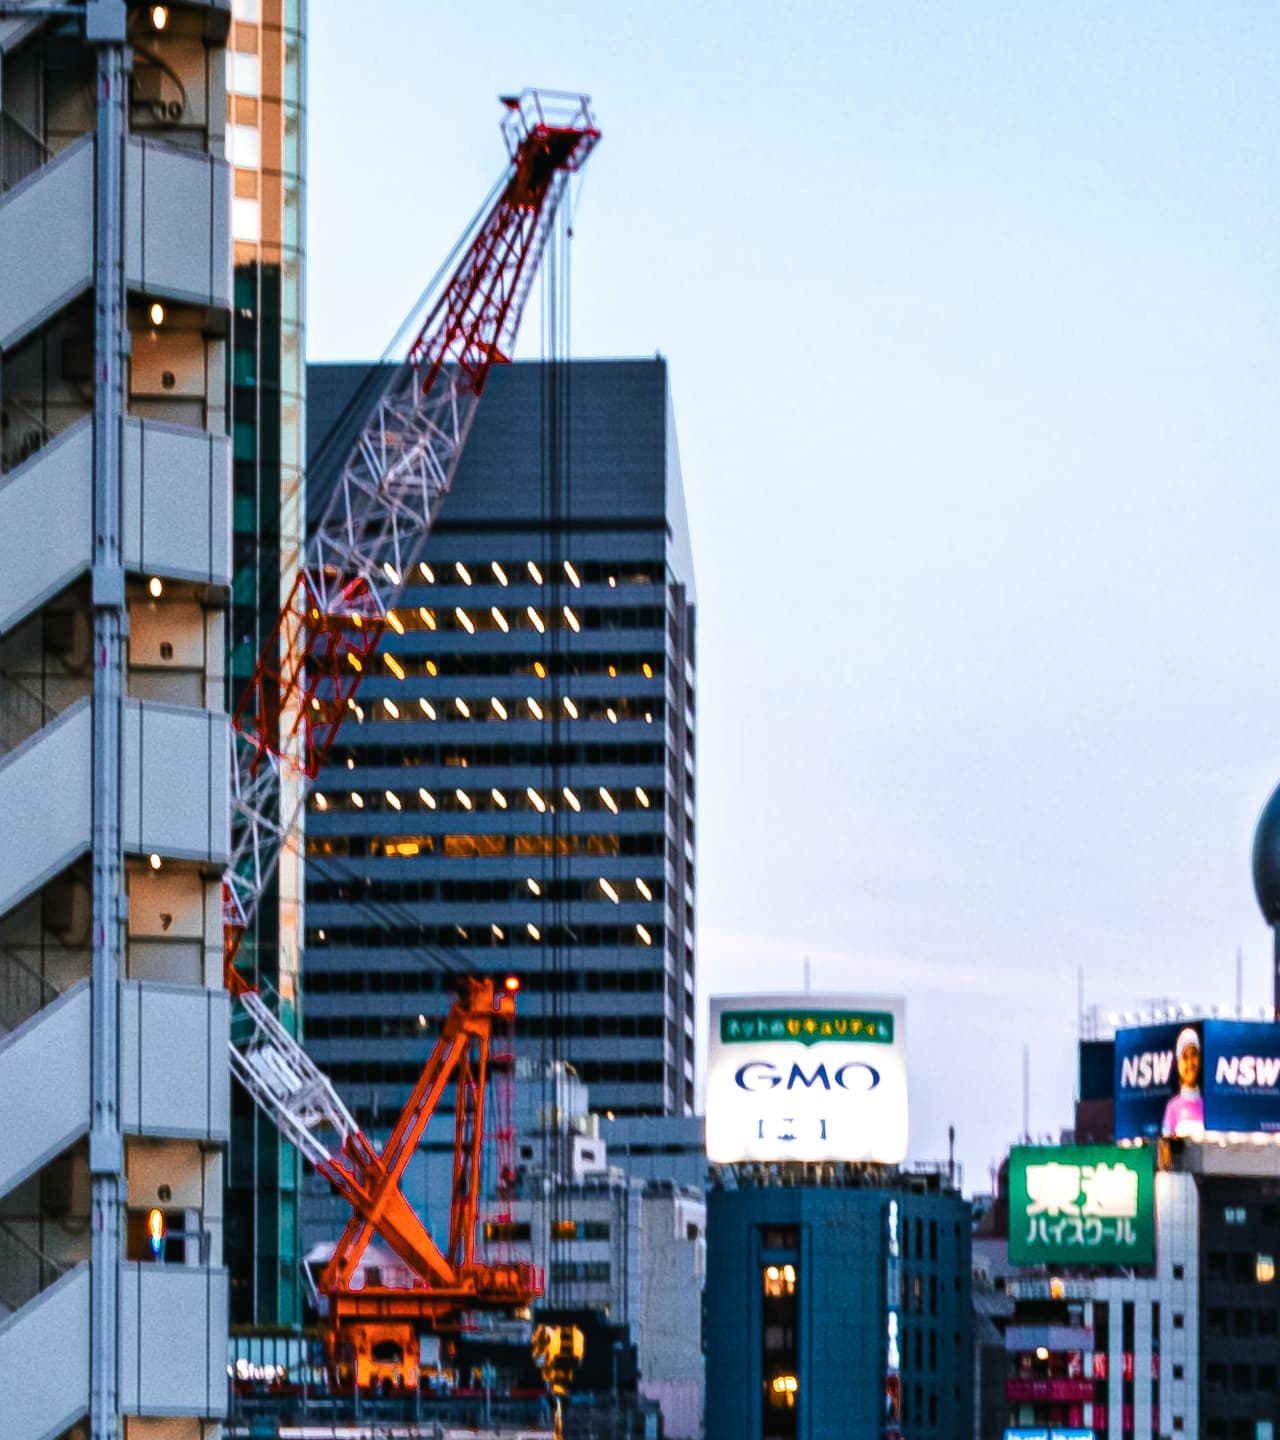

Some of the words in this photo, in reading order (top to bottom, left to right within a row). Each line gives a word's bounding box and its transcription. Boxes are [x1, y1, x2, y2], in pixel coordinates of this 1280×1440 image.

[160, 913, 172, 931] 7
[734, 1061, 880, 1091] GMO
[1121, 1050, 1173, 1088] NSW
[1026, 1162, 1138, 1217] 東進
[1027, 1218, 1136, 1245] ハイスクール
